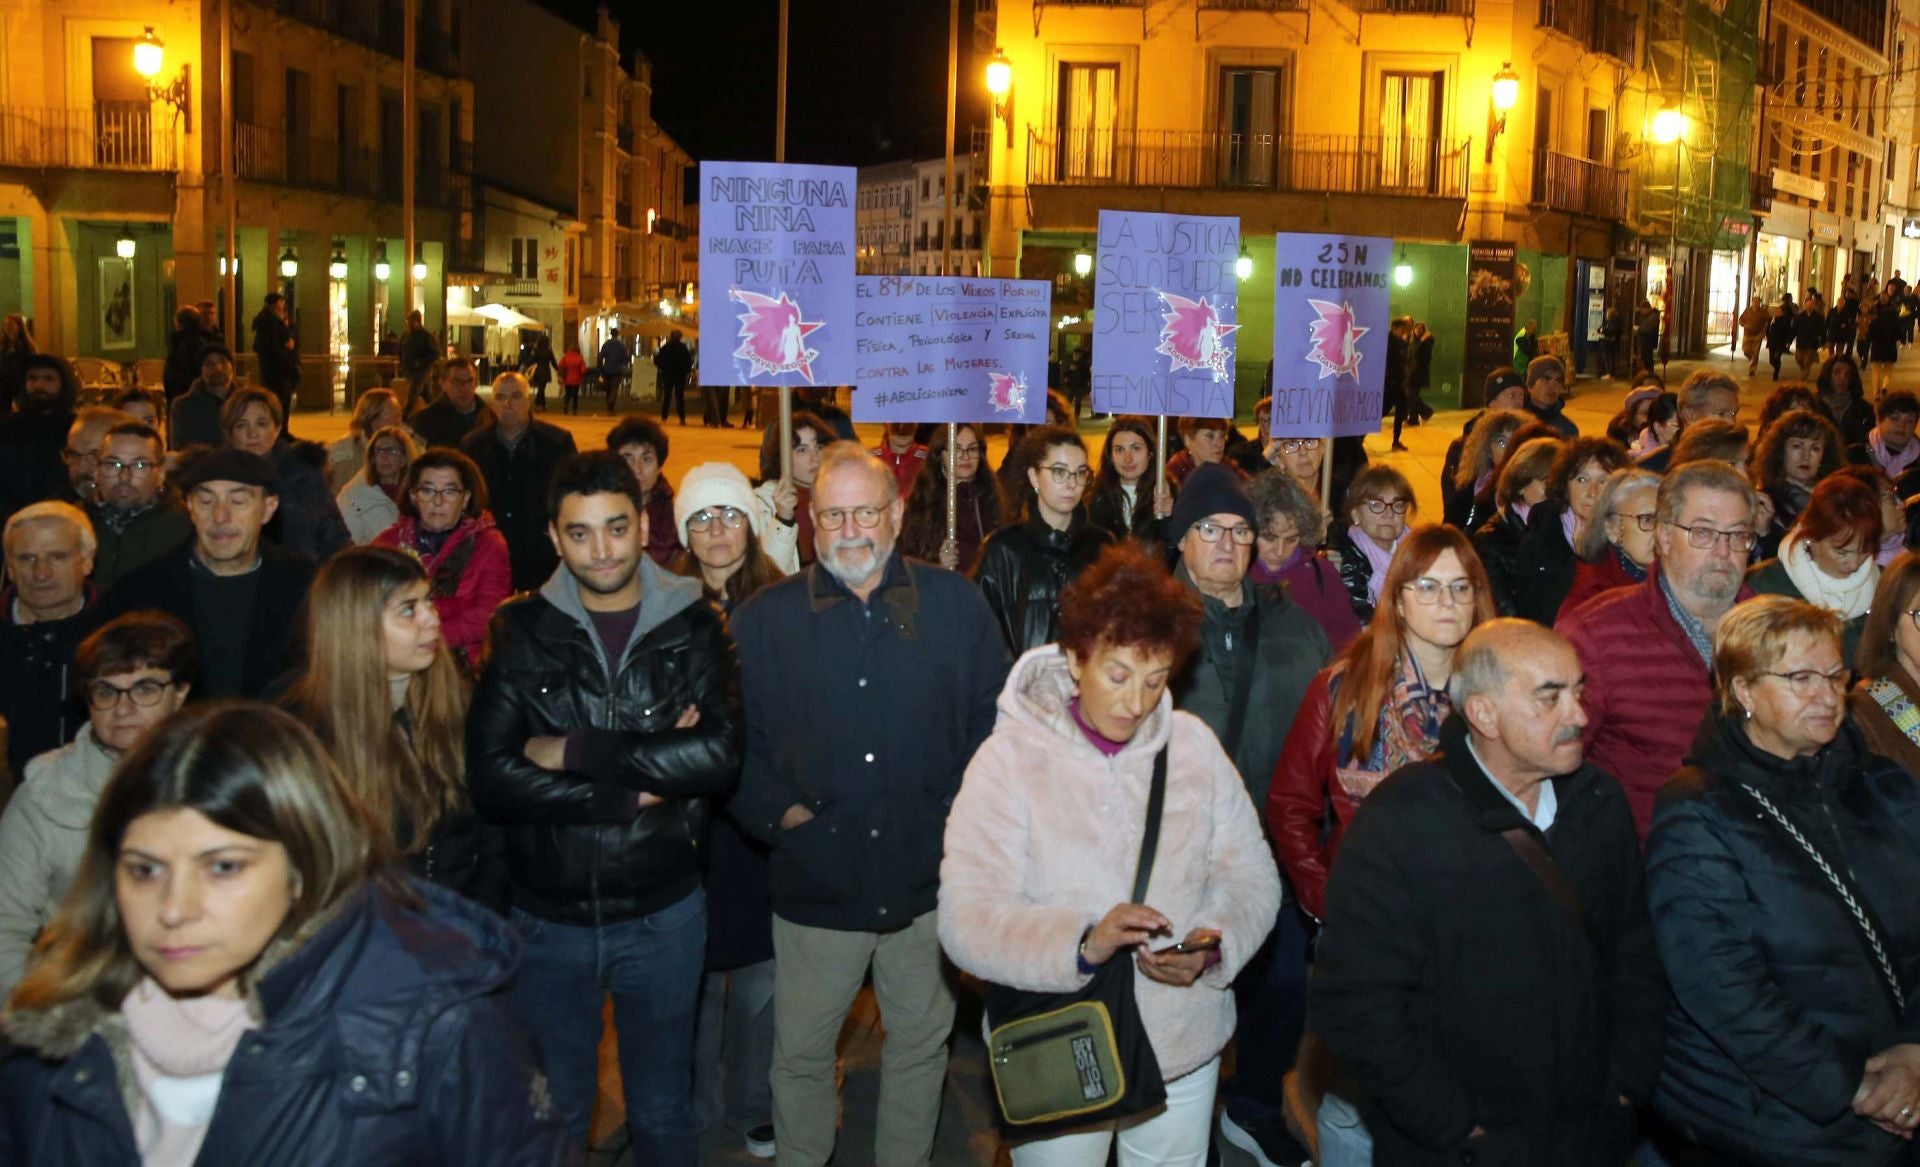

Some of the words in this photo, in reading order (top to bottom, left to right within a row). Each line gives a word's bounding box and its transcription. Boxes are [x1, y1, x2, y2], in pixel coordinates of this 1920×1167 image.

[711, 176, 848, 208] NINGUNA
[709, 236, 772, 254] NACE
[793, 240, 845, 255] PARA
[1099, 216, 1138, 248] LA
[1145, 221, 1238, 255] JUSTICIA
[735, 258, 822, 284] PUTA
[1281, 268, 1303, 287] NO
[1311, 268, 1387, 289] CELEBRAMOS
[856, 283, 873, 298] EL
[916, 282, 932, 296] DE
[1003, 283, 1040, 297] PORNO
[1097, 292, 1161, 335] SER
[856, 367, 909, 380] CONTRA
[1093, 374, 1232, 418] FEMINISTA
